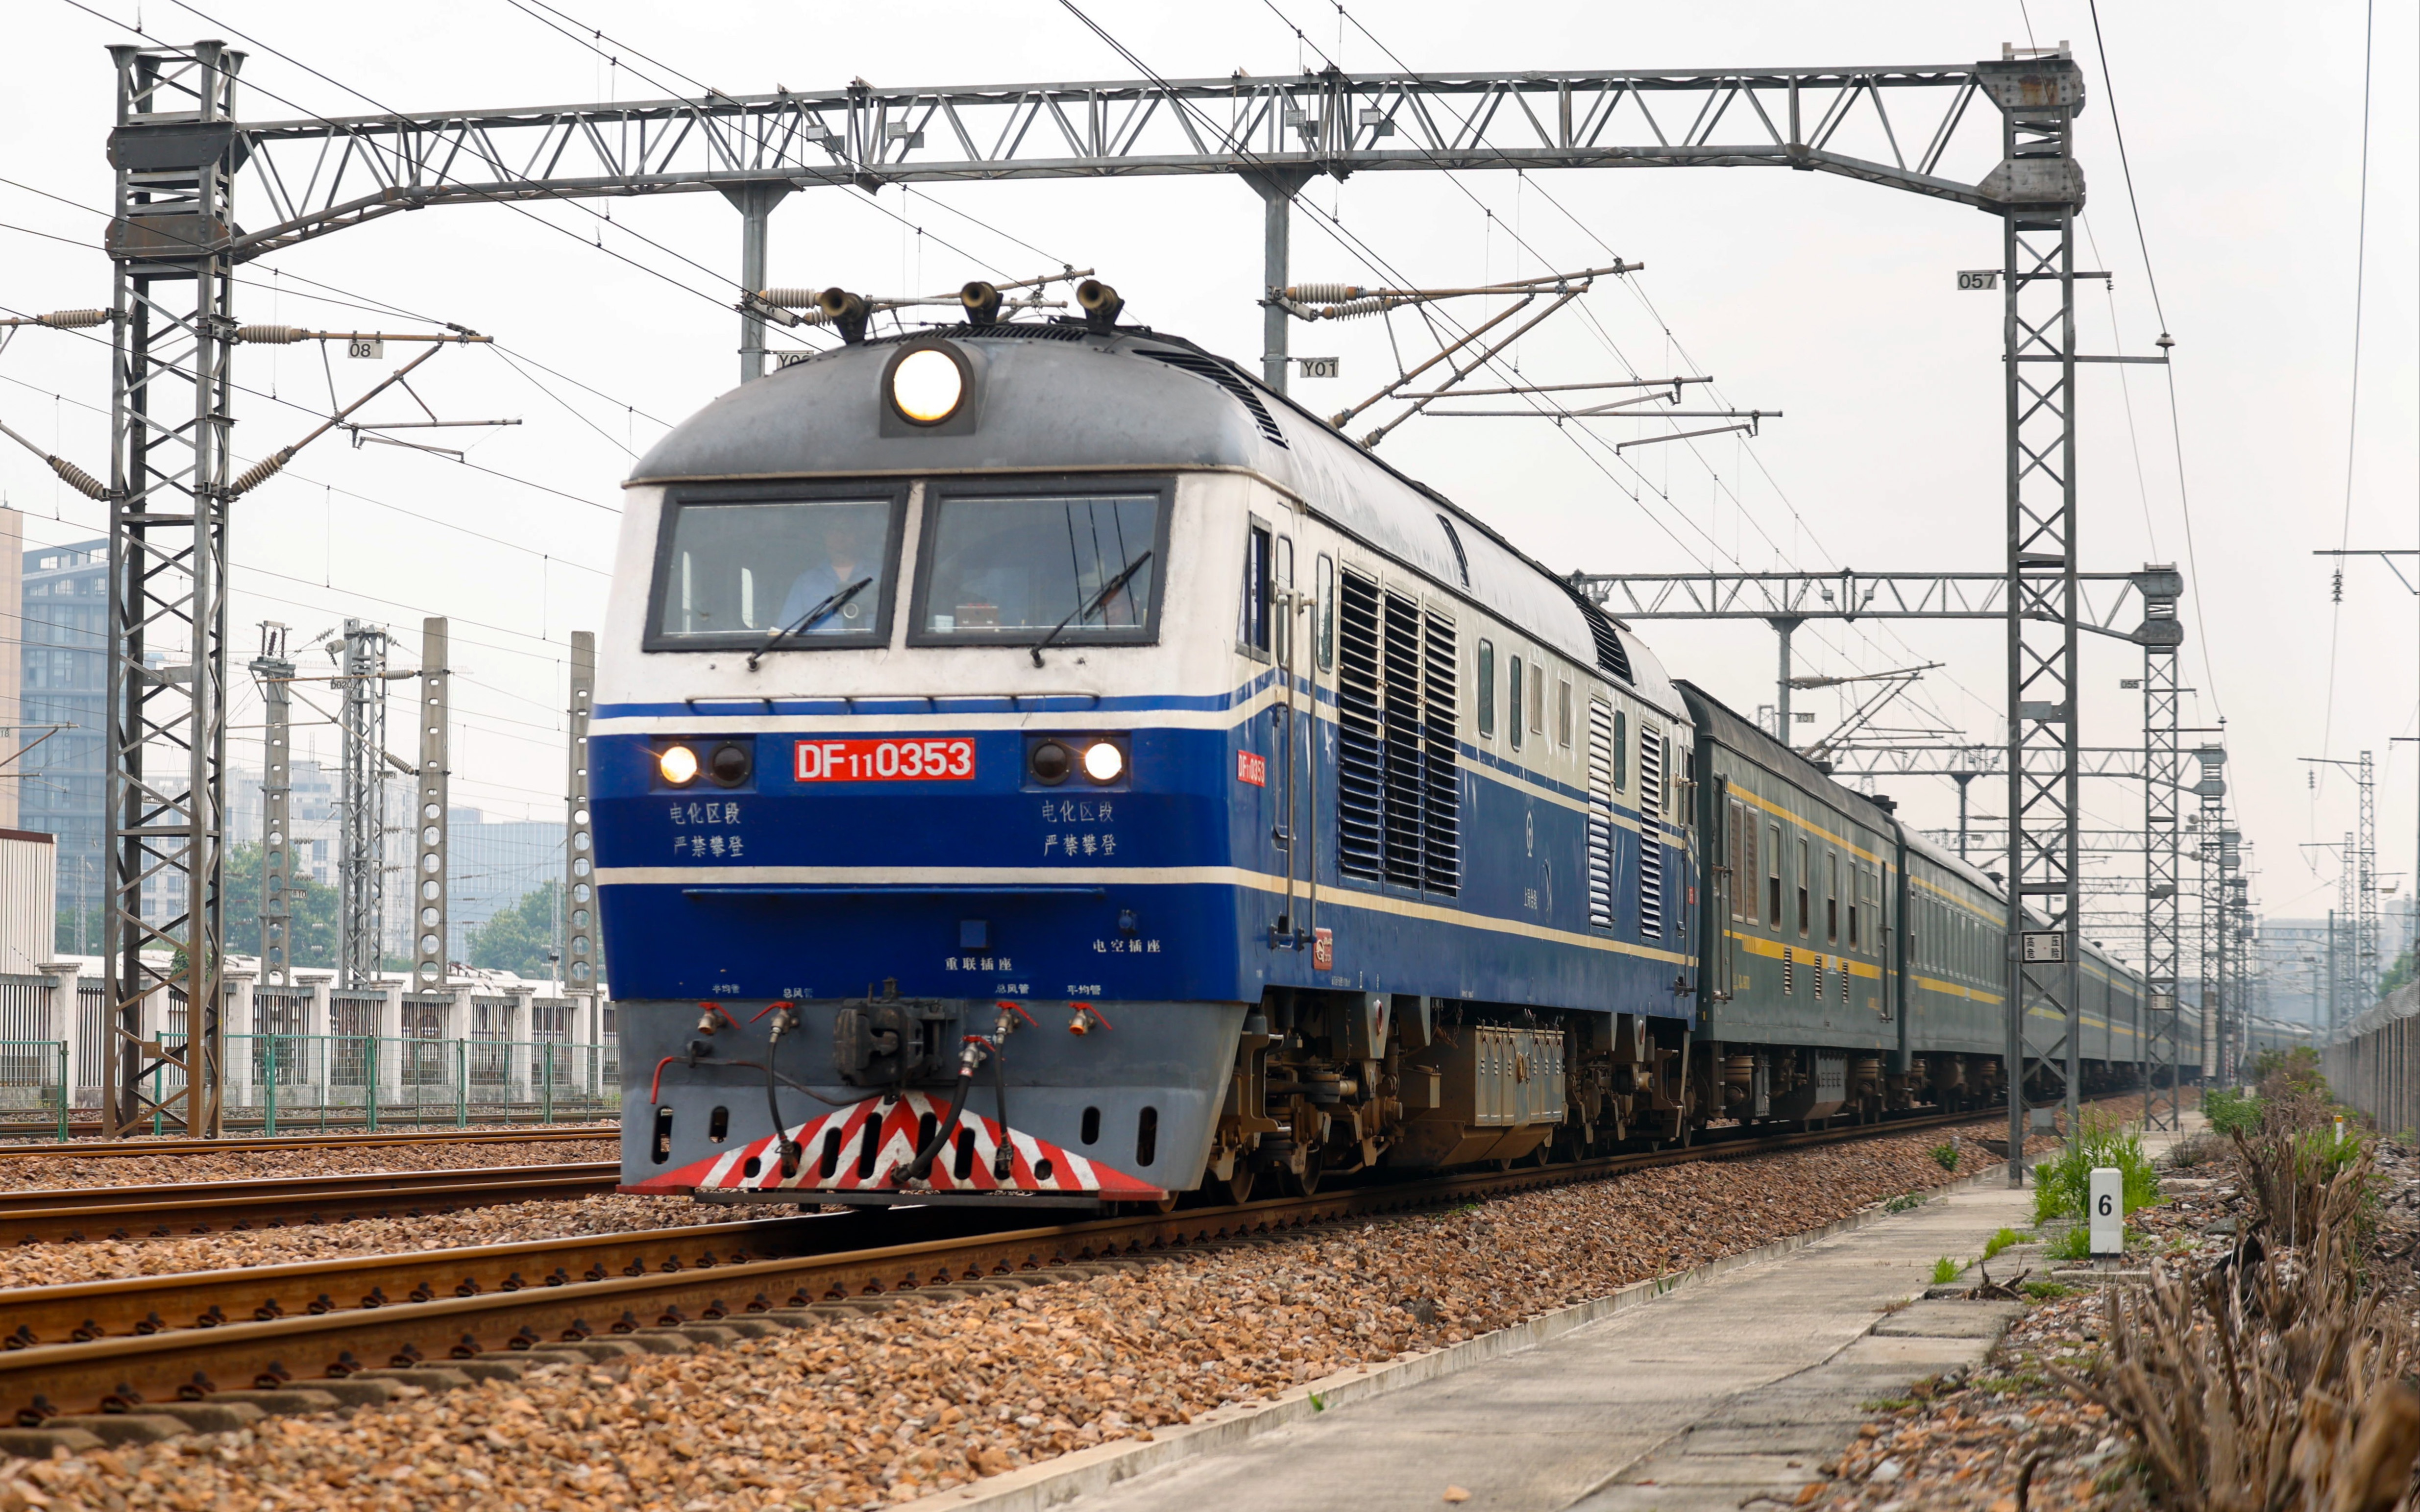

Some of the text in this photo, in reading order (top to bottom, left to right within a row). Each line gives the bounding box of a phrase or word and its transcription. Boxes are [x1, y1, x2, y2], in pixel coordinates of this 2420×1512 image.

[1960, 273, 1996, 289] 057
[349, 343, 371, 357] 08
[2121, 681, 2139, 689] 055
[799, 742, 972, 778] DF110353
[670, 802, 741, 824] 电化区段
[1042, 801, 1113, 822] 电化区段
[674, 835, 744, 857] 严禁攀登
[1044, 834, 1116, 856] 严禁攀登
[1093, 939, 1160, 952] 电空插座
[945, 957, 1012, 971] 重联插座
[712, 984, 740, 994] 平均管
[996, 984, 1029, 994] 总风管
[1067, 985, 1101, 995] 平均管
[2098, 1194, 2112, 1216] 6
